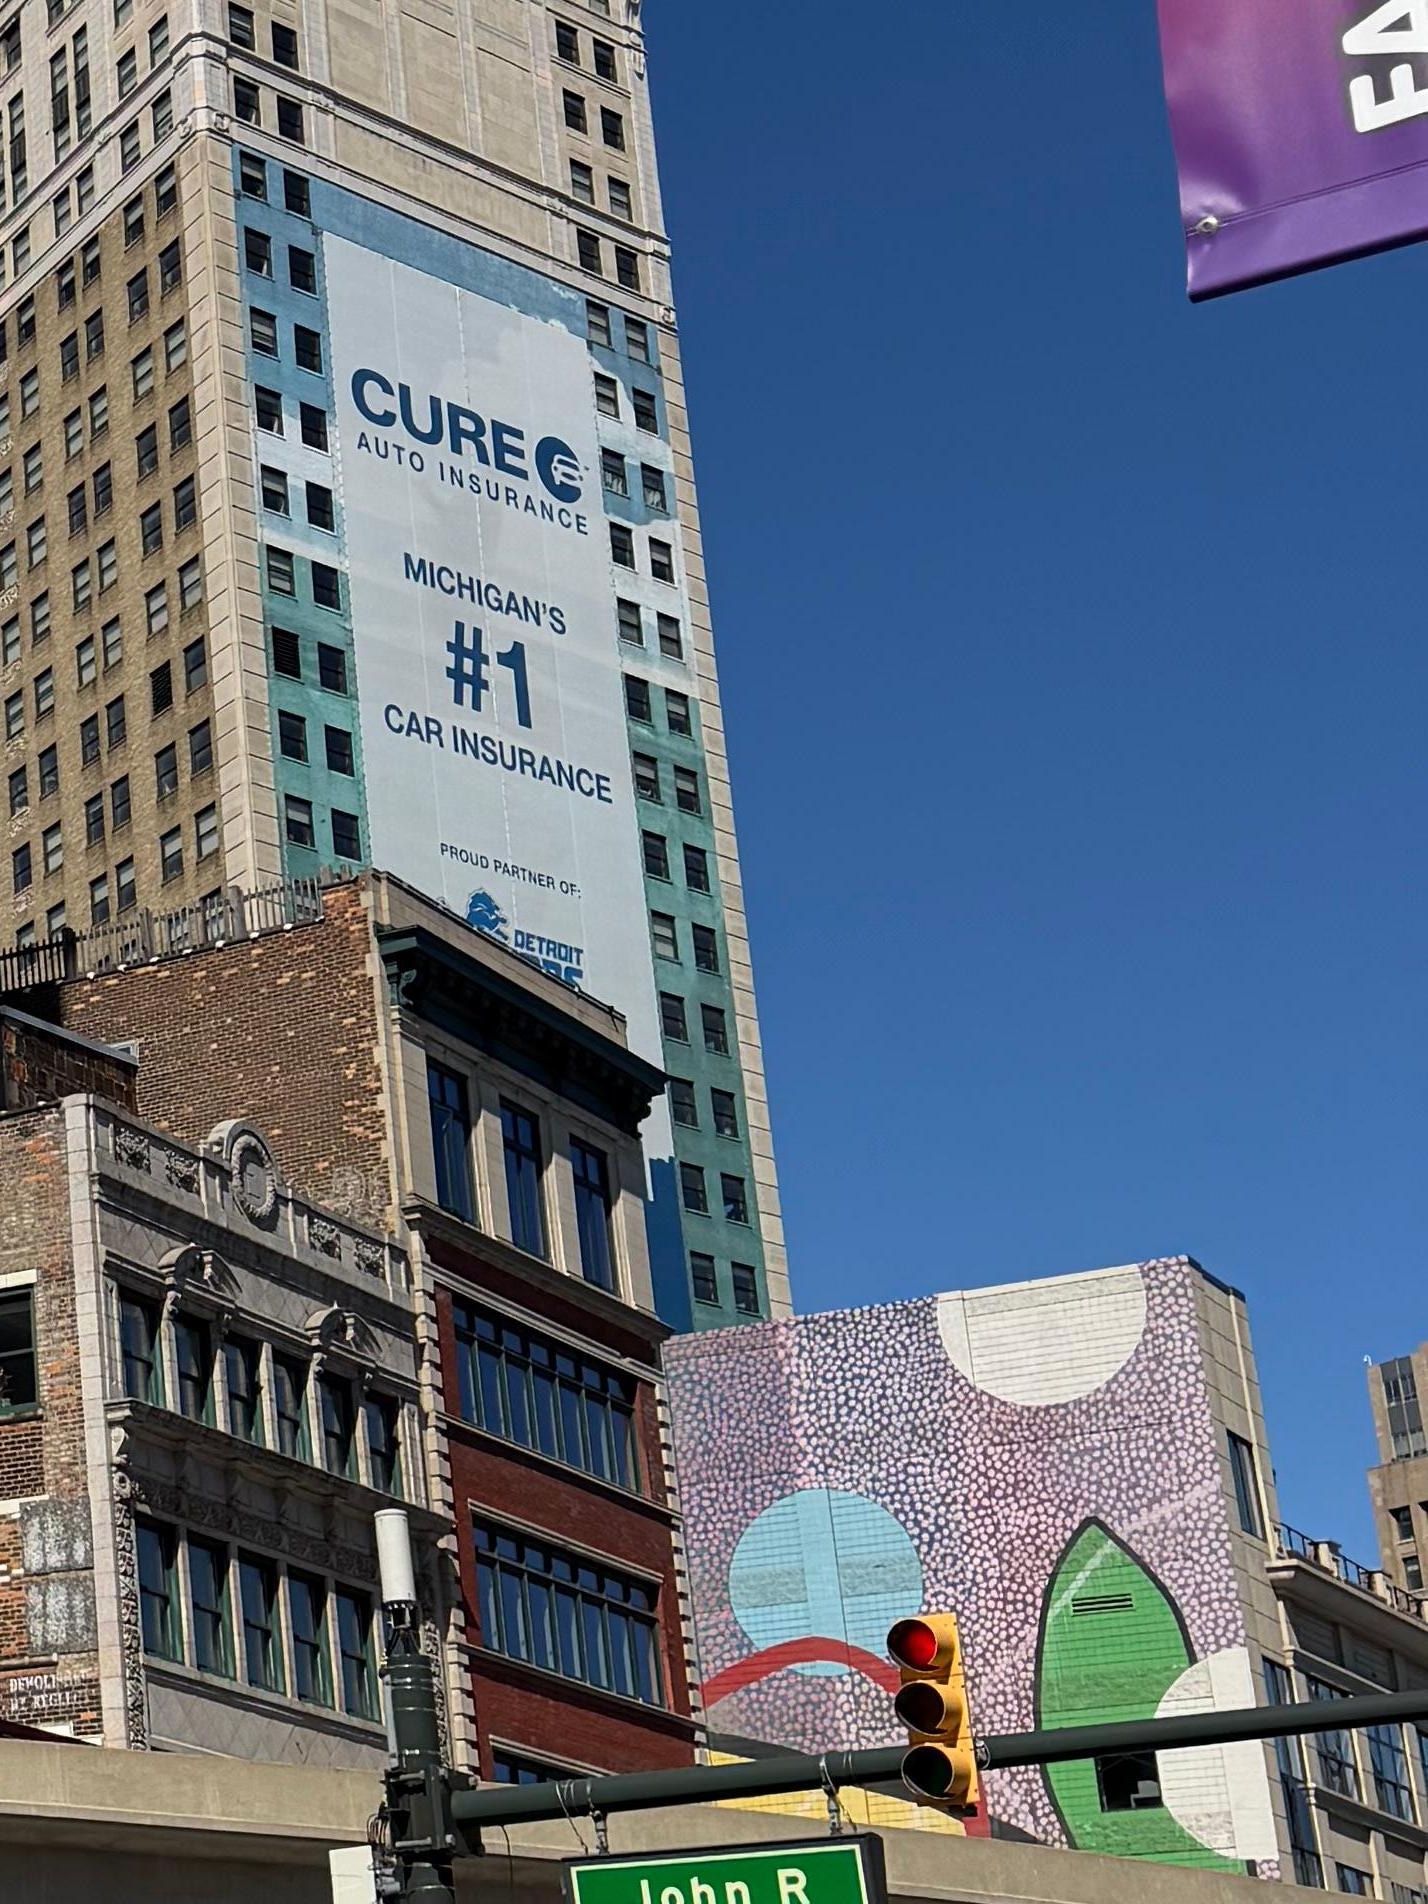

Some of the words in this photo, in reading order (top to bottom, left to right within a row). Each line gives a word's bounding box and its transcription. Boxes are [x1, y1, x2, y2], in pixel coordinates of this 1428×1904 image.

[351, 368, 529, 482] CURE
[357, 432, 425, 473] AUTO
[439, 463, 589, 536] INSURANCE
[403, 552, 568, 636] MICHIGAN'S
[445, 620, 533, 730] #1
[383, 704, 446, 749] CAR
[452, 725, 614, 805] INSURANCE
[440, 842, 489, 869] PROUD
[493, 859, 556, 890] PARTNER
[559, 880, 581, 899] OF:
[514, 929, 584, 966] DETROIT
